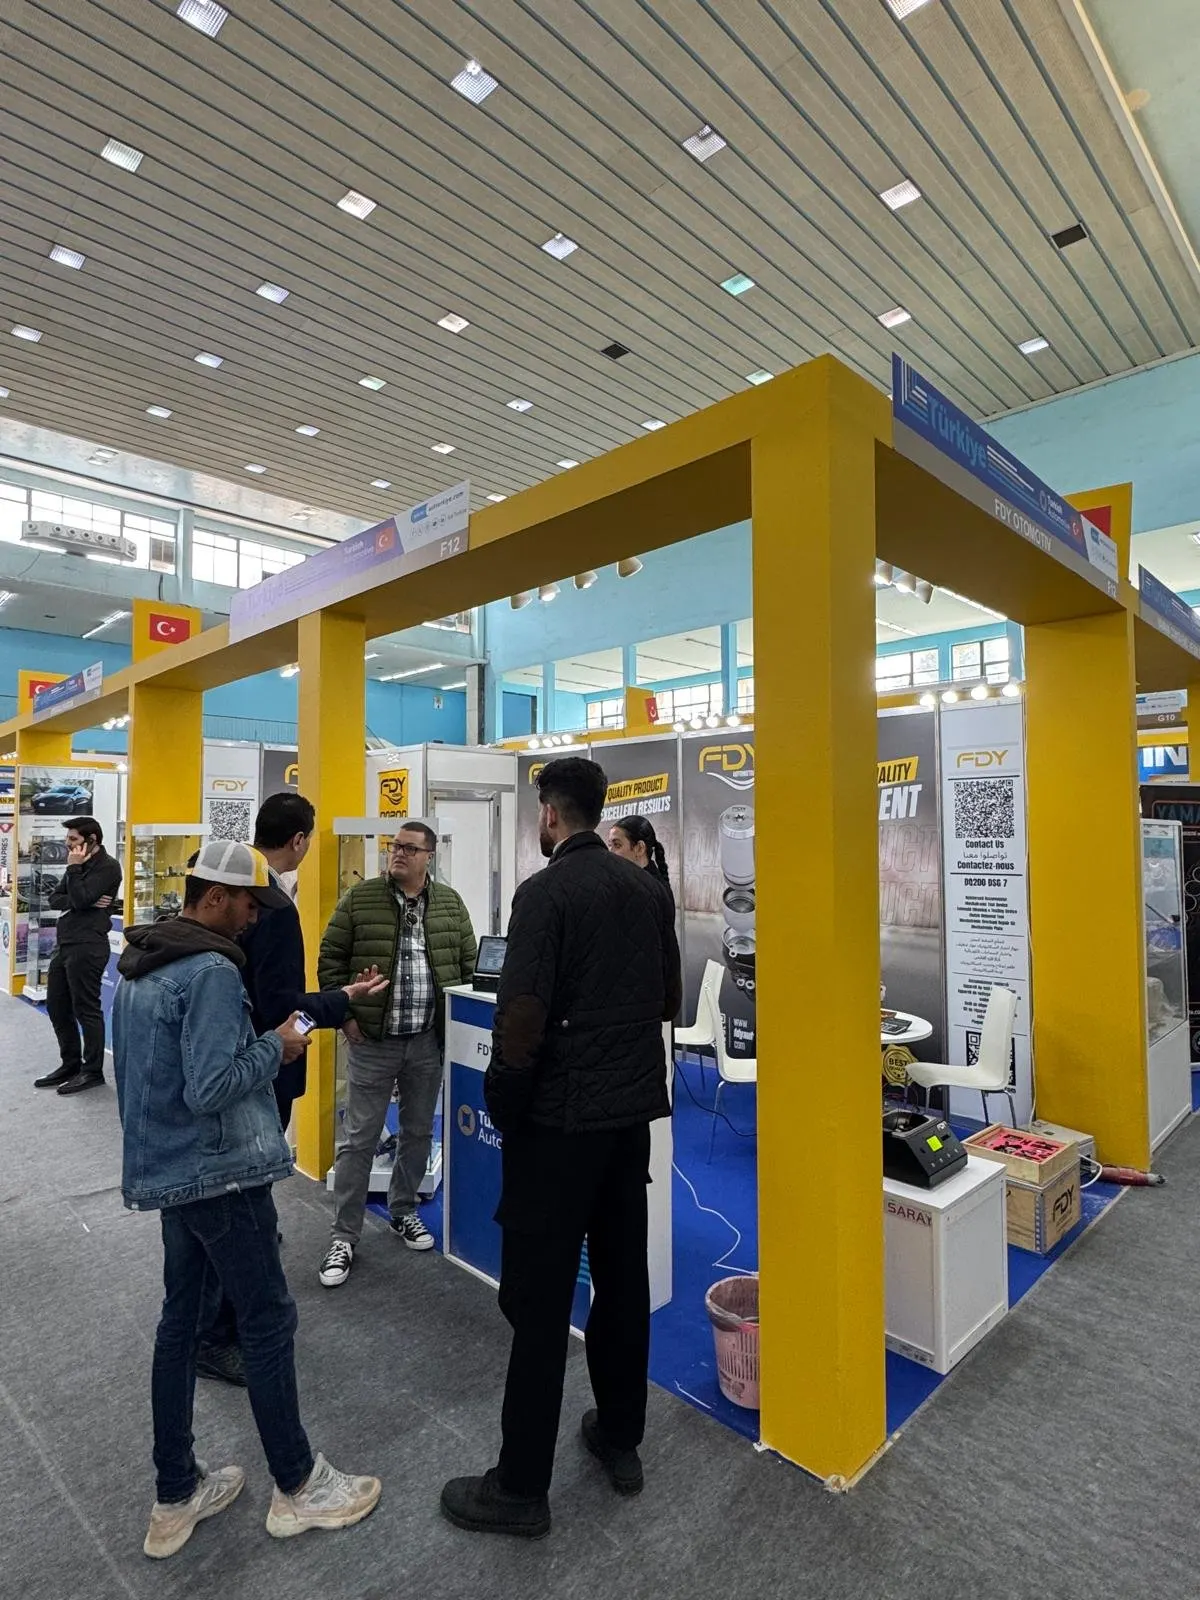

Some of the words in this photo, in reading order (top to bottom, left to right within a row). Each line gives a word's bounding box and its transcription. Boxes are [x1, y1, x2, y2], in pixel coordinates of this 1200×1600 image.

[928, 397, 986, 468] Türkiye
[994, 498, 1012, 525] FDY
[1012, 512, 1052, 552] OTOMOTIV
[440, 537, 460, 558] F12
[1157, 714, 1176, 722] G10
[957, 749, 1009, 768] FDY
[878, 762, 912, 784] ALITY
[212, 779, 248, 792] FDY
[381, 776, 406, 795] FDY
[607, 783, 632, 801] QUALITY
[632, 777, 664, 796] PRODUCT
[638, 796, 671, 815] RESULTS
[965, 840, 993, 849] Contact
[995, 840, 1005, 849] Us
[957, 860, 1015, 870] Contactez-nous
[964, 878, 986, 887] DQ200
[988, 879, 1001, 887] DSG
[1003, 879, 1008, 888] 7
[889, 1057, 907, 1067] BEST
[1052, 1184, 1075, 1222] FDY
[887, 1202, 933, 1227] SARAY
